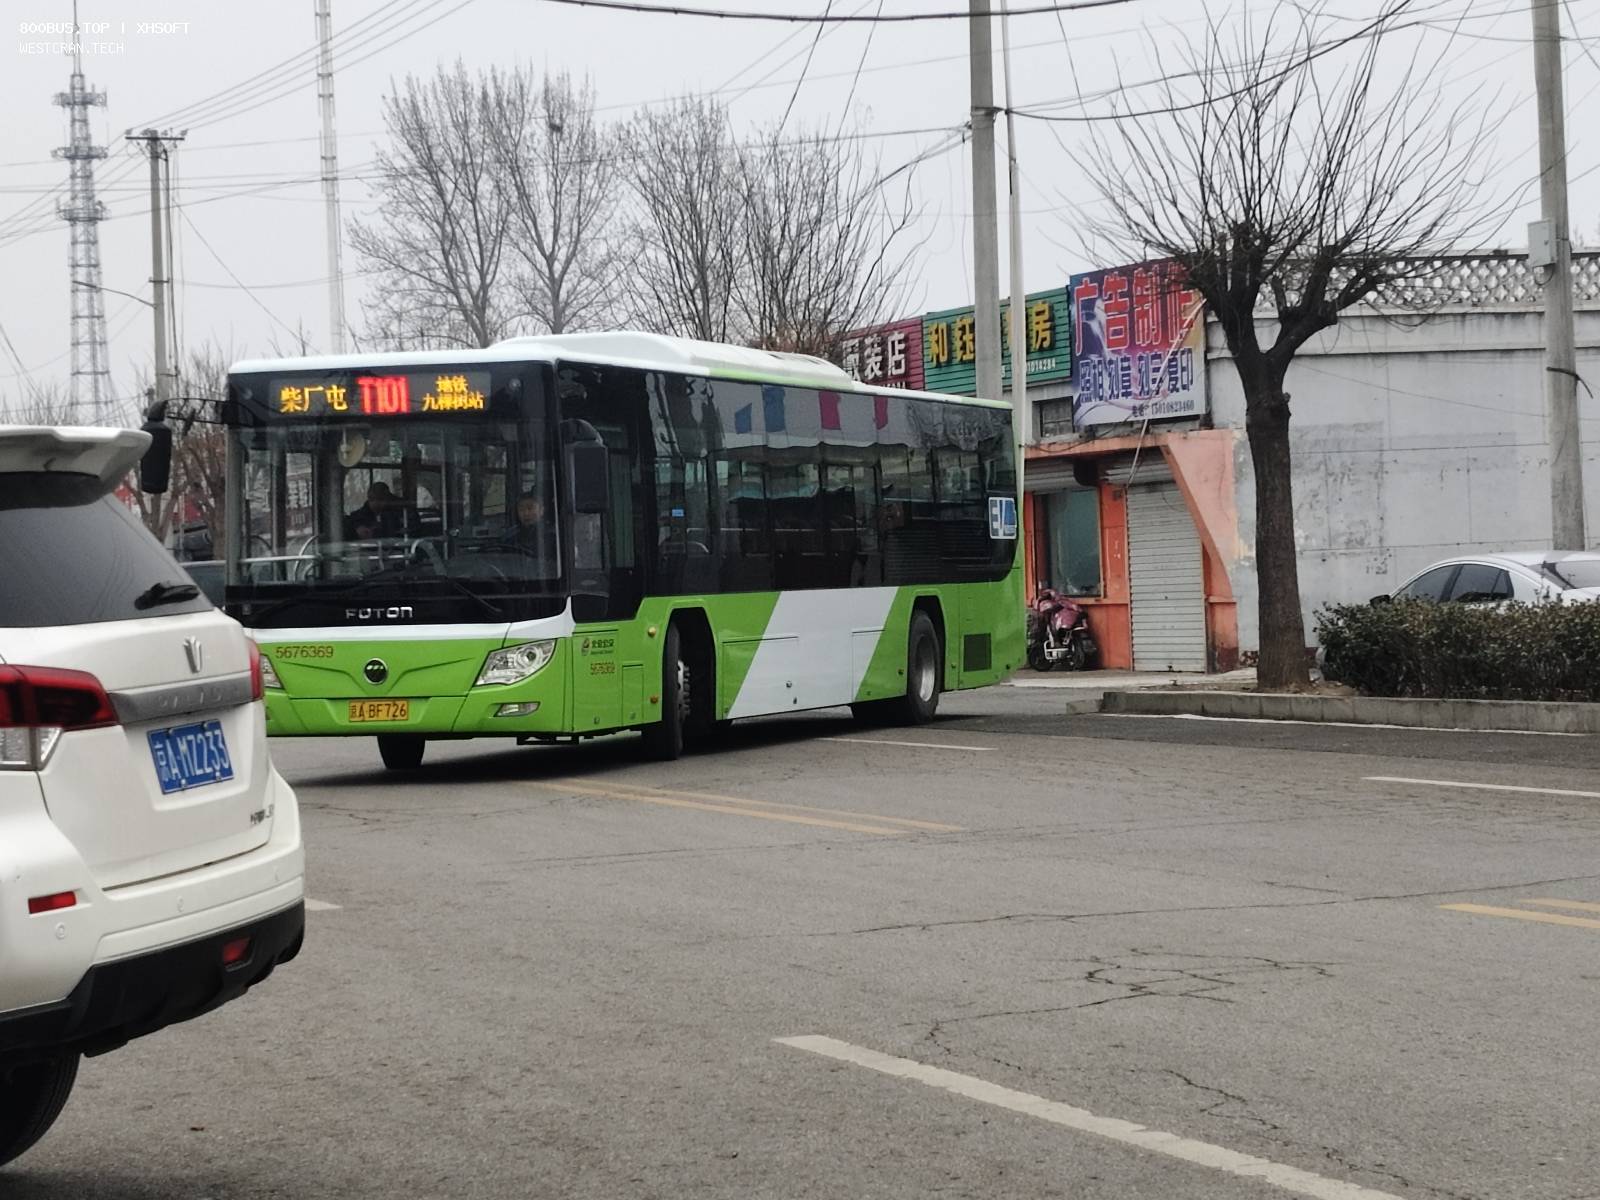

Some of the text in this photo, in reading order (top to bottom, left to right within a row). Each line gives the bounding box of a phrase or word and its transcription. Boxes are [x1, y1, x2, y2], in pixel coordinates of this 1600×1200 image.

[1075, 262, 1195, 356] 广告制作
[436, 376, 468, 392] 地铁
[280, 384, 347, 413] 柴厂屯
[357, 376, 411, 415] T101
[422, 391, 484, 412] 九棵树站
[345, 606, 413, 619] FOTON
[276, 645, 334, 659] 5676369
